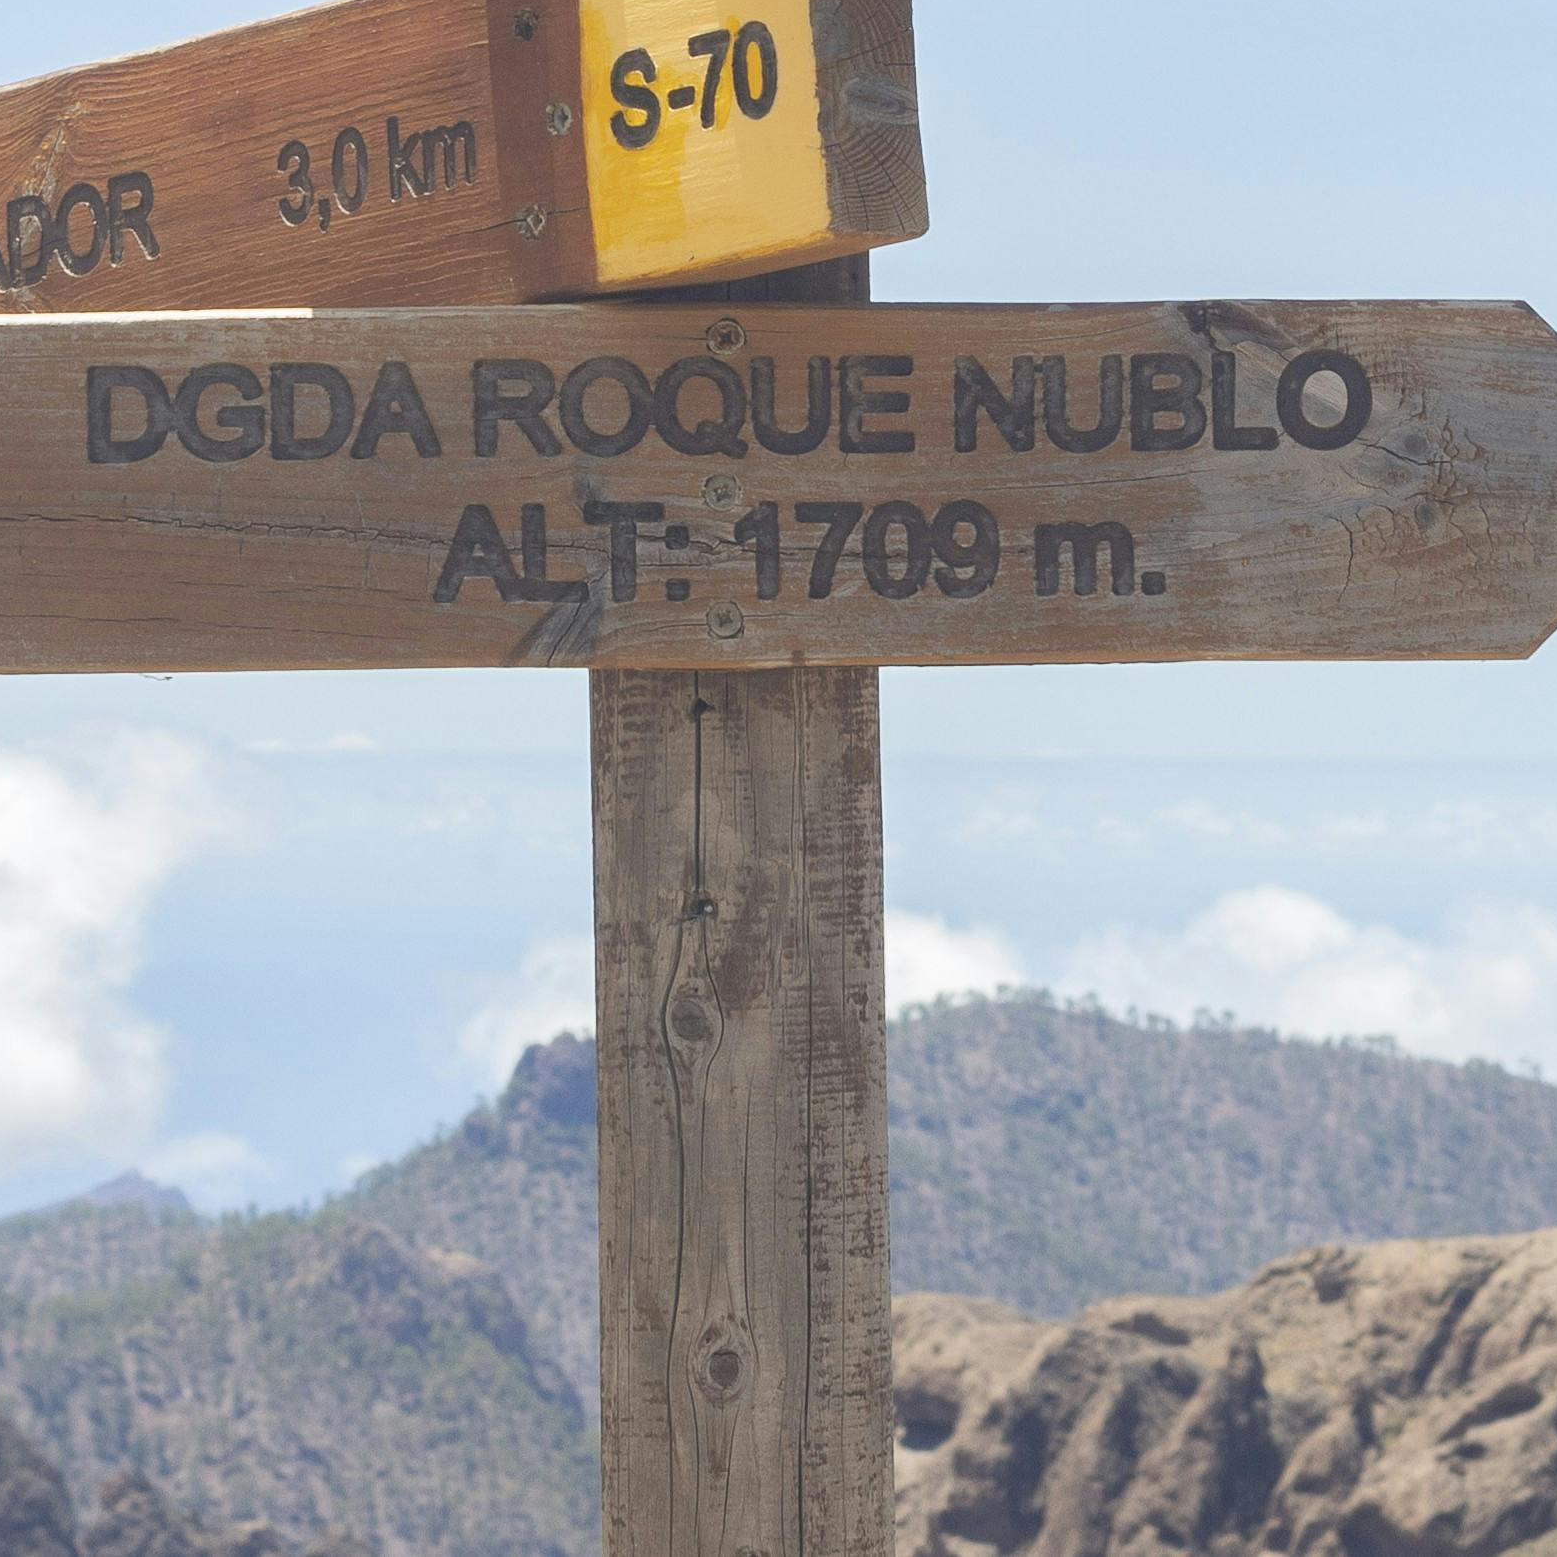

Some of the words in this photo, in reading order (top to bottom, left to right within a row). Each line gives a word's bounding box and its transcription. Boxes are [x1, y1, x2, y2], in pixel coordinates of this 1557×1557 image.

[609, 19, 779, 152] S-70
[276, 126, 369, 235] 3,0
[387, 115, 477, 203] km
[86, 360, 442, 464] DGDA
[472, 353, 916, 460] ROQUE
[953, 347, 1374, 454] NUBLO
[432, 500, 691, 604] ALT:
[733, 498, 1002, 601] 1709
[1034, 520, 1169, 599] m.
